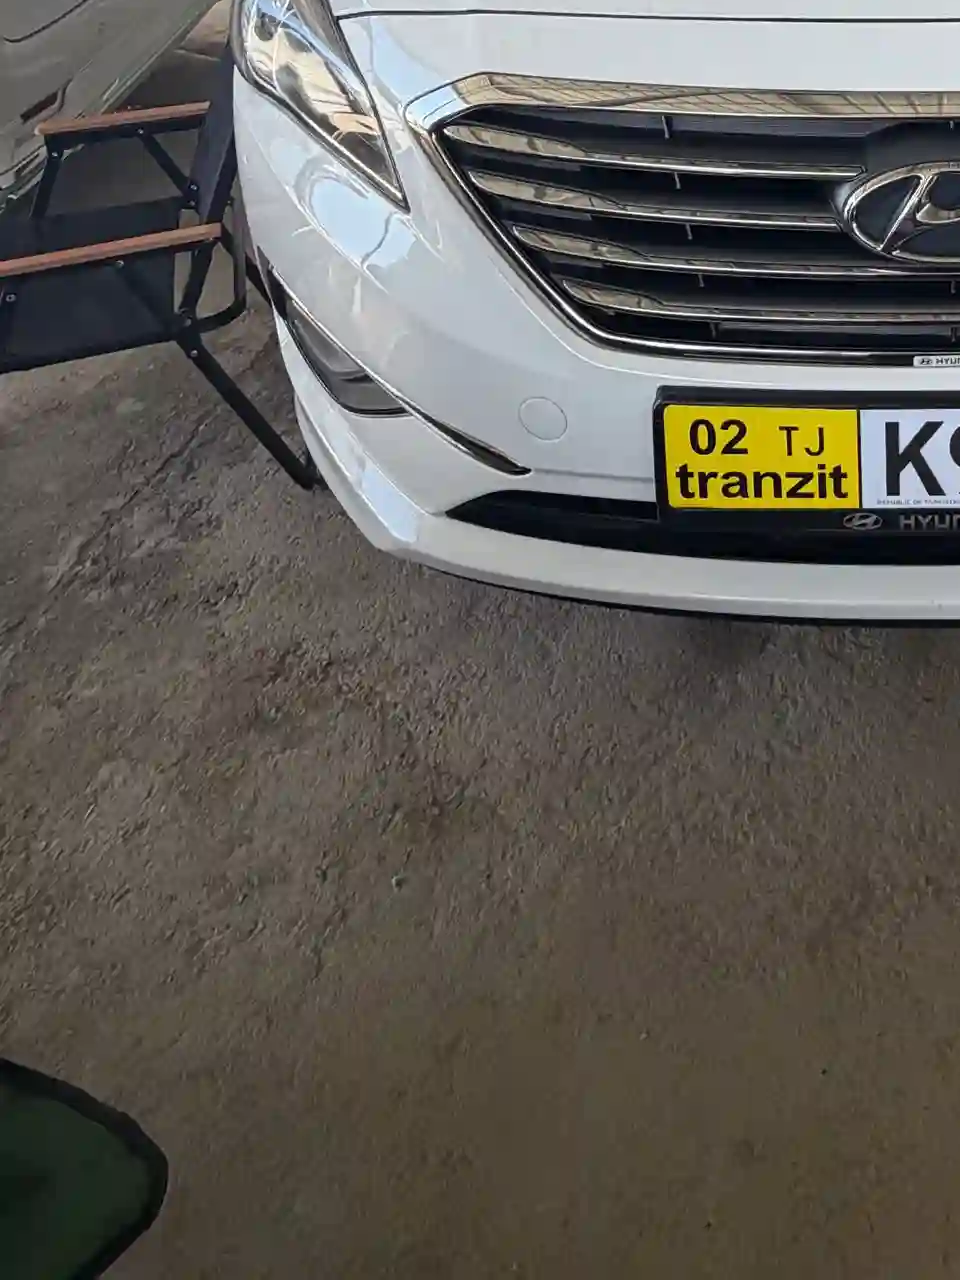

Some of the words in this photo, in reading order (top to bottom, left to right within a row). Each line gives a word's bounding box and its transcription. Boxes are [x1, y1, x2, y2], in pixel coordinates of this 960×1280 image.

[689, 418, 748, 456] 02
[780, 425, 826, 457] TJ
[675, 463, 848, 501] tranzit
